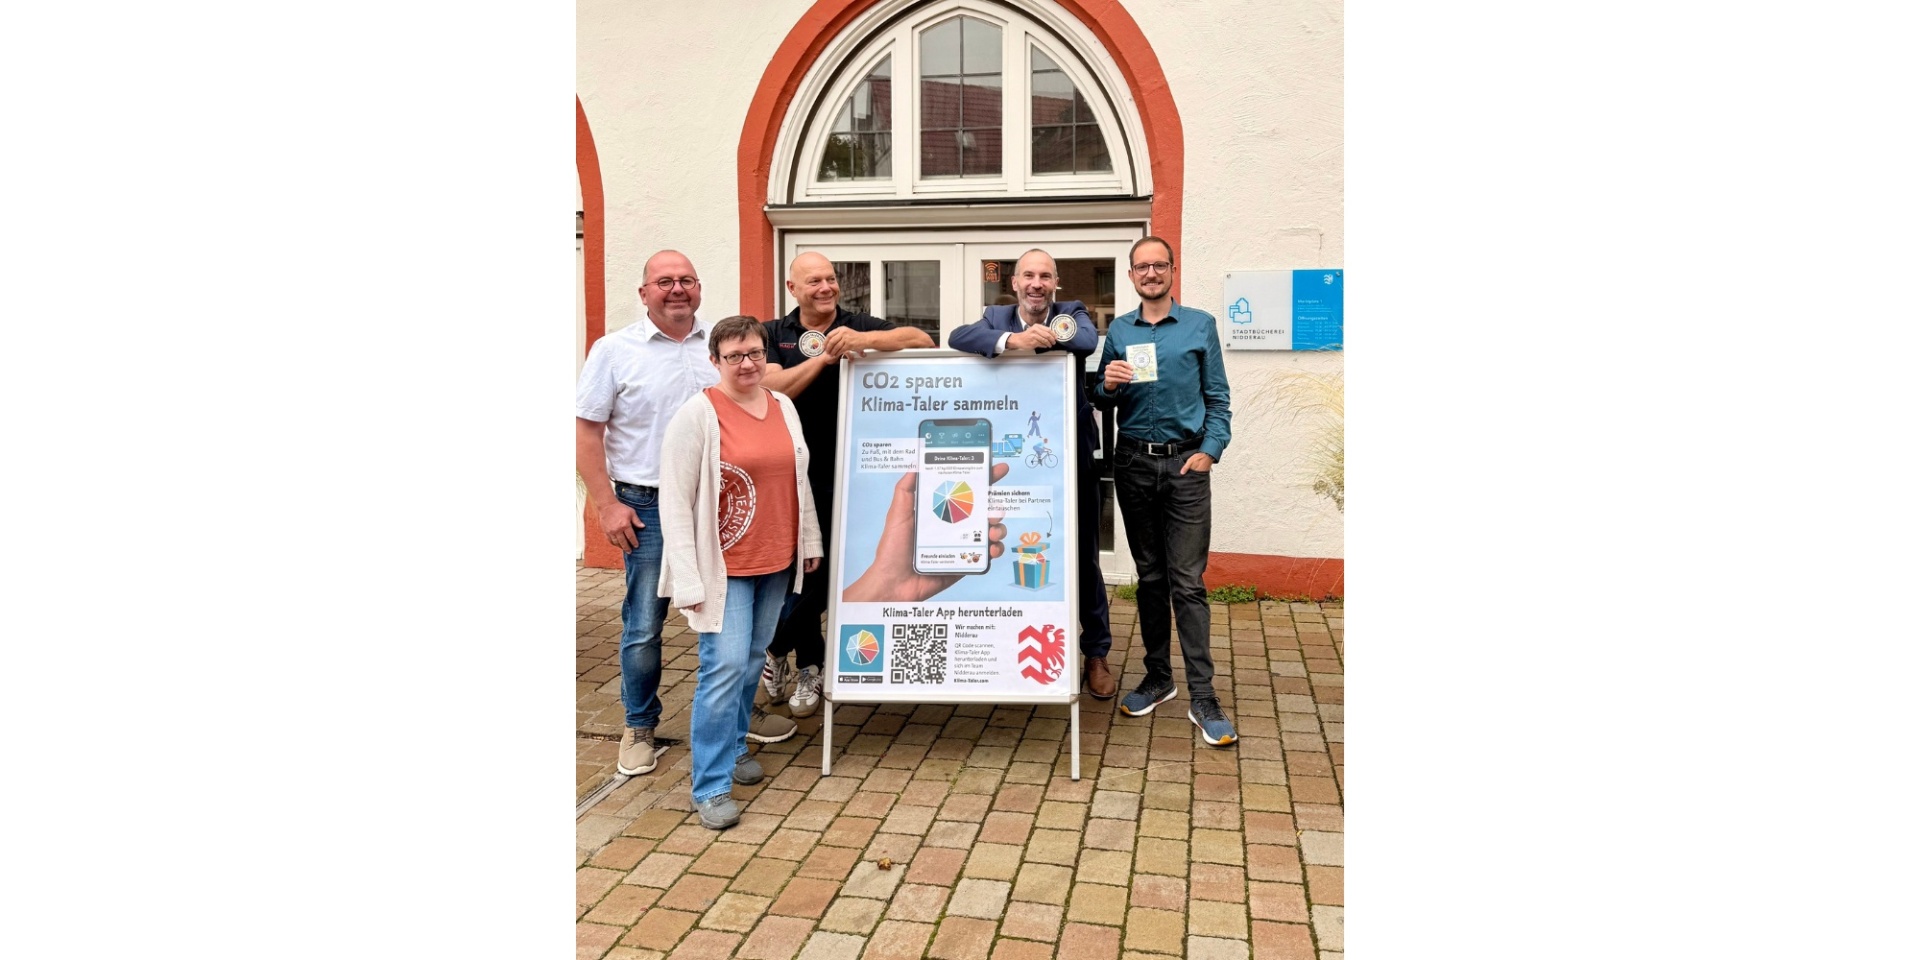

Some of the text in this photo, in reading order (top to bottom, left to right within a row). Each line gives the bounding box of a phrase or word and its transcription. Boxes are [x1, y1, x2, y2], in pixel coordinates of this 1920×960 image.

[863, 372, 963, 393] CO2 sparen
[861, 395, 1019, 412] Klima-Taler sammeln
[882, 606, 1023, 620] Klima-Taler App herunterladen
